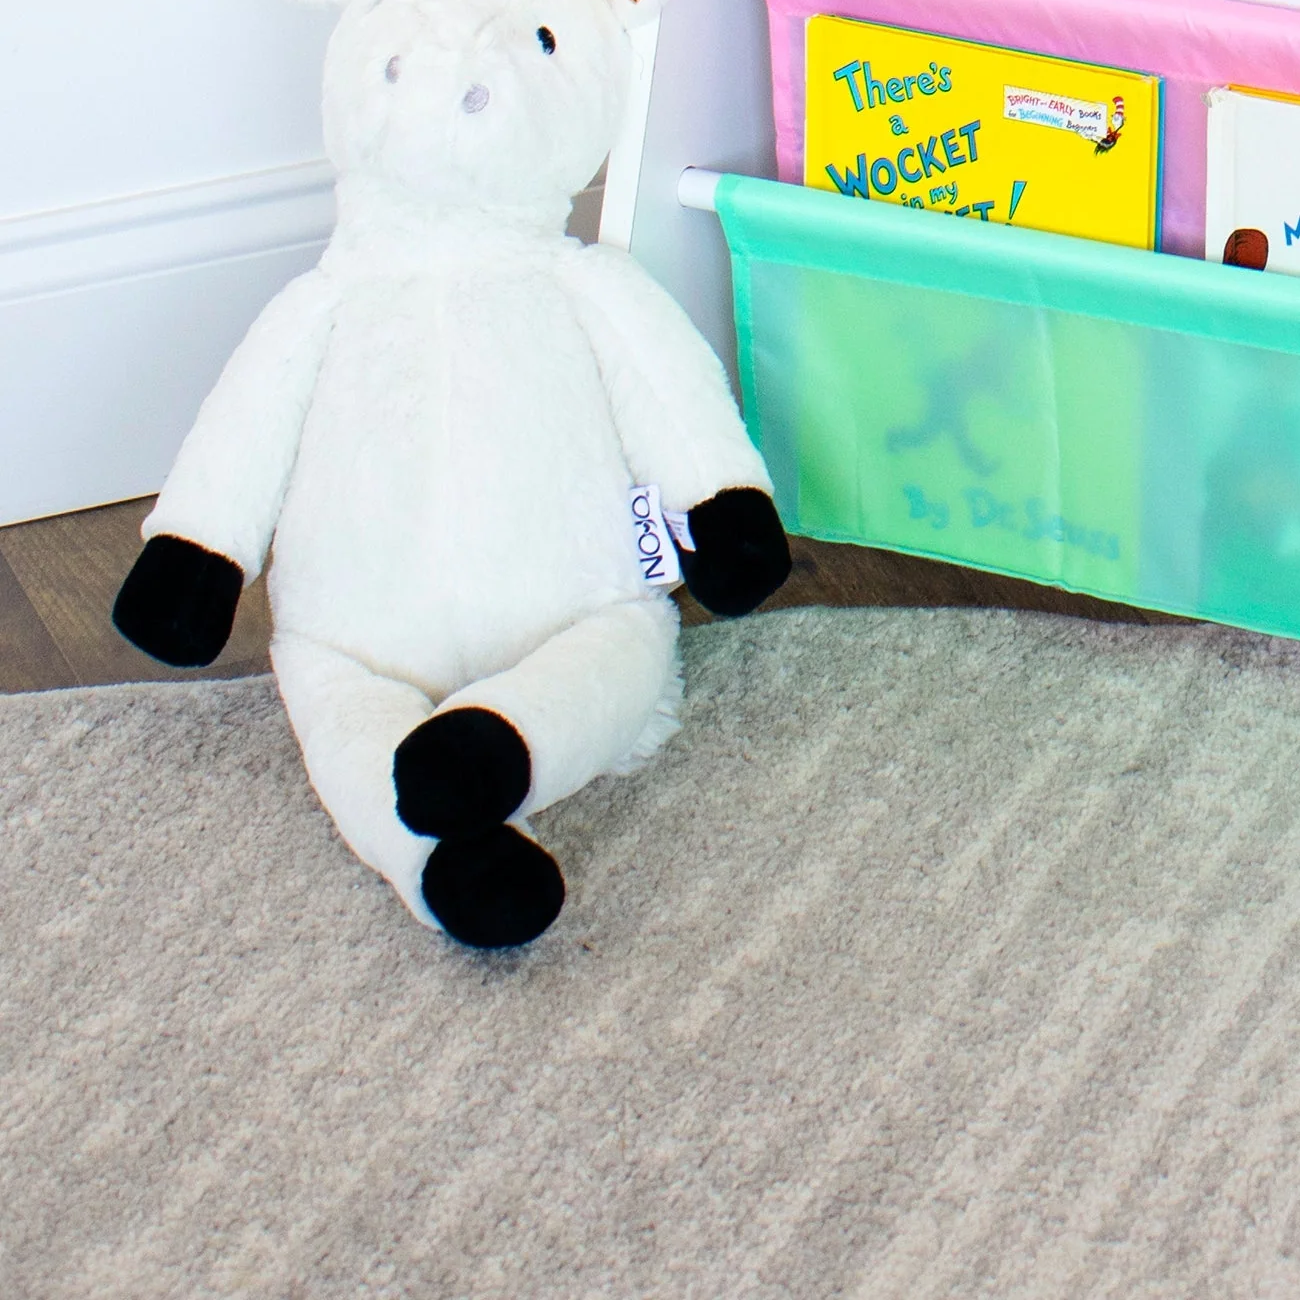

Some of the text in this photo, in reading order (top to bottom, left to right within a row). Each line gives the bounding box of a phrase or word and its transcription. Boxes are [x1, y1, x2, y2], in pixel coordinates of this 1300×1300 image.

[833, 60, 953, 111] There's
[1007, 95, 1041, 107] BRIGHT
[1048, 100, 1075, 116] EARLY
[888, 114, 909, 136] a
[1018, 108, 1064, 128] BEGINNING
[825, 119, 981, 200] WOCKET
[929, 181, 958, 204] my
